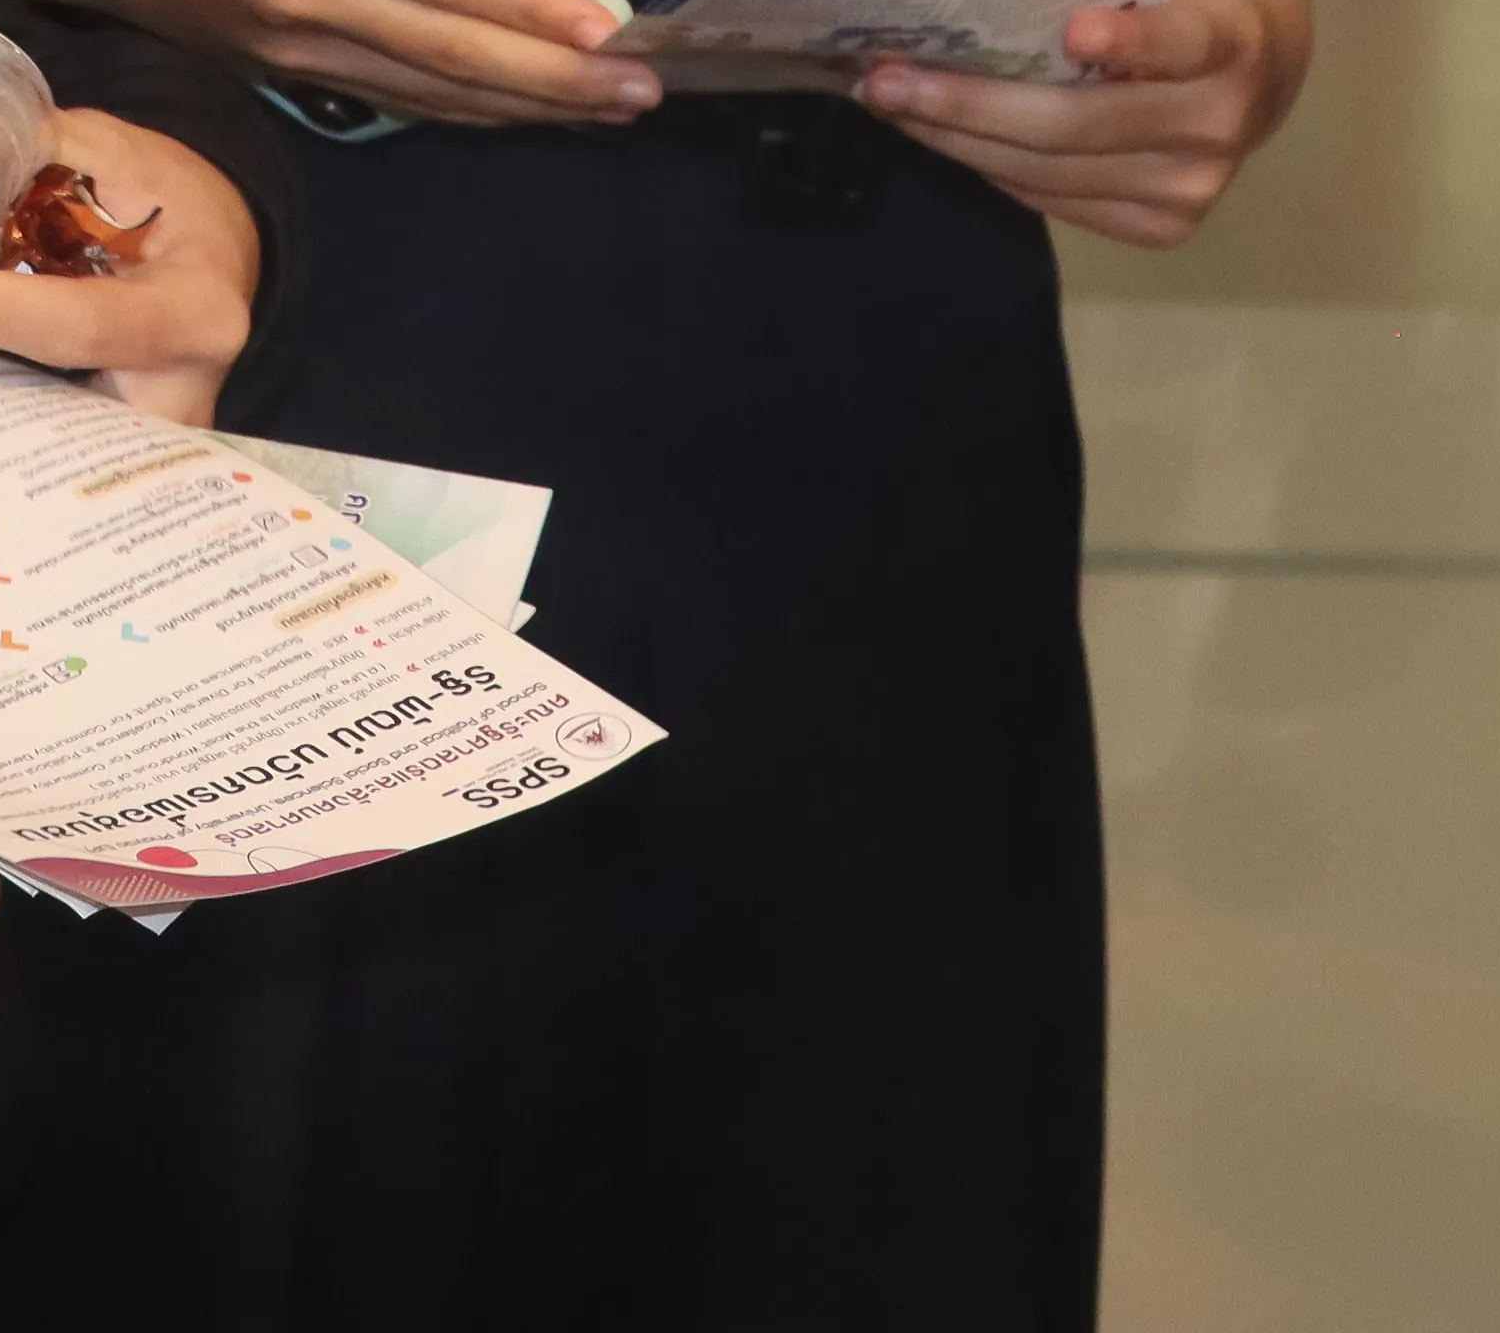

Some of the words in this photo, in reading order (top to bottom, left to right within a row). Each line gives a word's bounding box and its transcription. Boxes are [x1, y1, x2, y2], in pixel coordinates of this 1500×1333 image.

[274, 692, 323, 716] Wisdom
[327, 665, 503, 755] รัฐ-พัฒน์
[495, 682, 548, 712] School
[480, 707, 496, 721] of
[131, 731, 185, 755] Wisdom
[419, 716, 479, 747] Political
[389, 743, 419, 761] and
[214, 693, 570, 848] คณะรัฐศาสตร์และสังคมศาสตร์
[343, 757, 391, 781] Social
[461, 757, 571, 809] SPSS
[11, 743, 329, 841] นวัตกรเพื่อชุมชน
[194, 804, 274, 831] University
